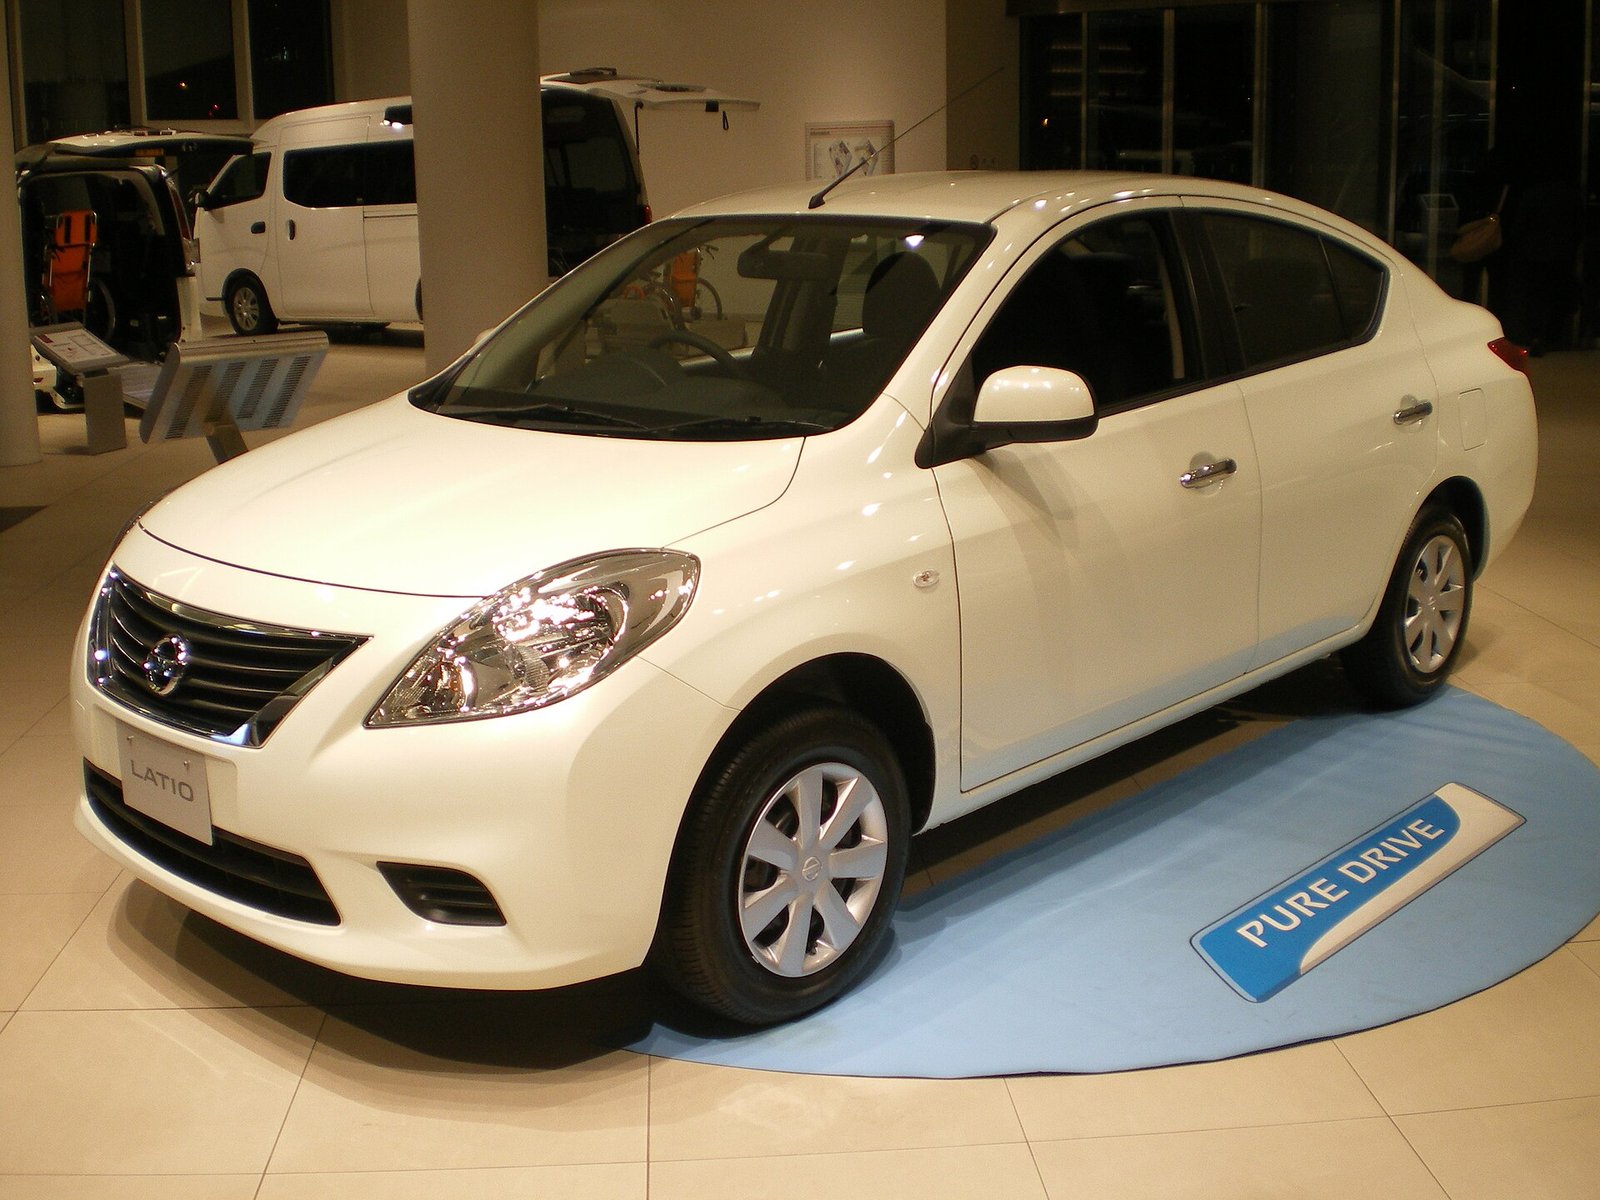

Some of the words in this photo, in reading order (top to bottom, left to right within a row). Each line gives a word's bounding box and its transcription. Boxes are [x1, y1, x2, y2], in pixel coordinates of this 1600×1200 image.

[131, 760, 194, 802] LATIO
[1237, 878, 1349, 948] PURE
[1338, 818, 1445, 884] DRIVE
